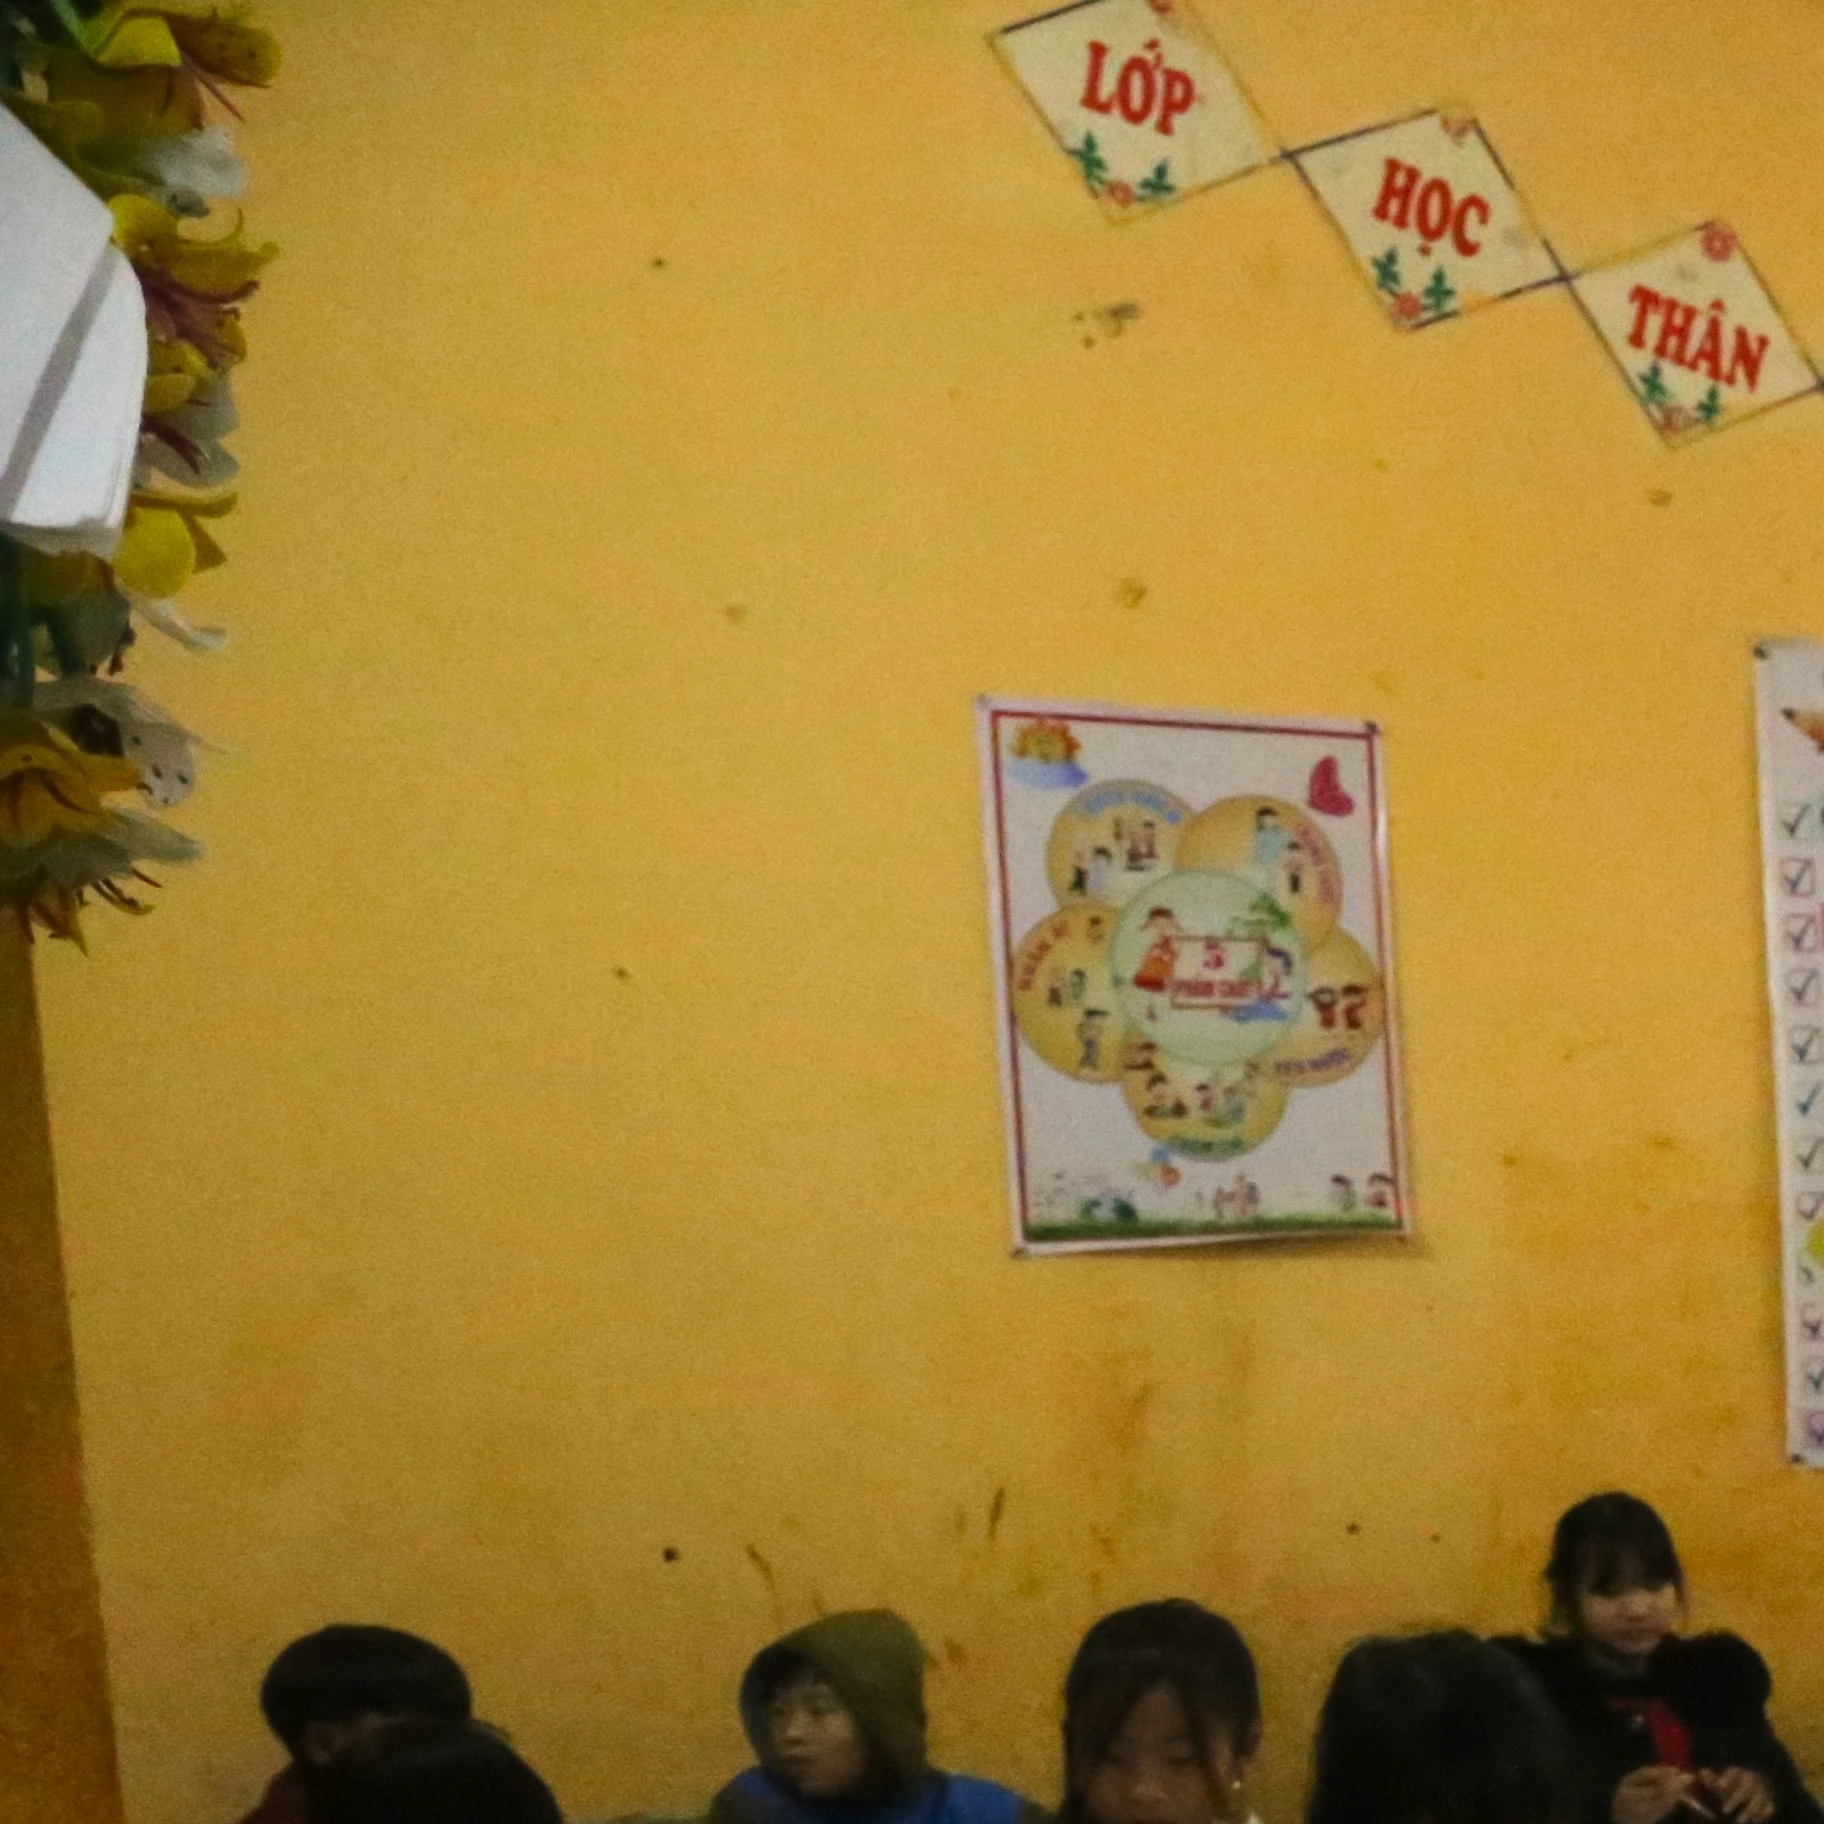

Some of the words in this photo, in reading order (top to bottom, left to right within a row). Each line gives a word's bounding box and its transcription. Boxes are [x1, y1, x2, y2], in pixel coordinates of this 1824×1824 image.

[1080, 38, 1197, 137] LỚP
[1372, 156, 1491, 258] HỌC
[1627, 283, 1771, 394] THÂN
